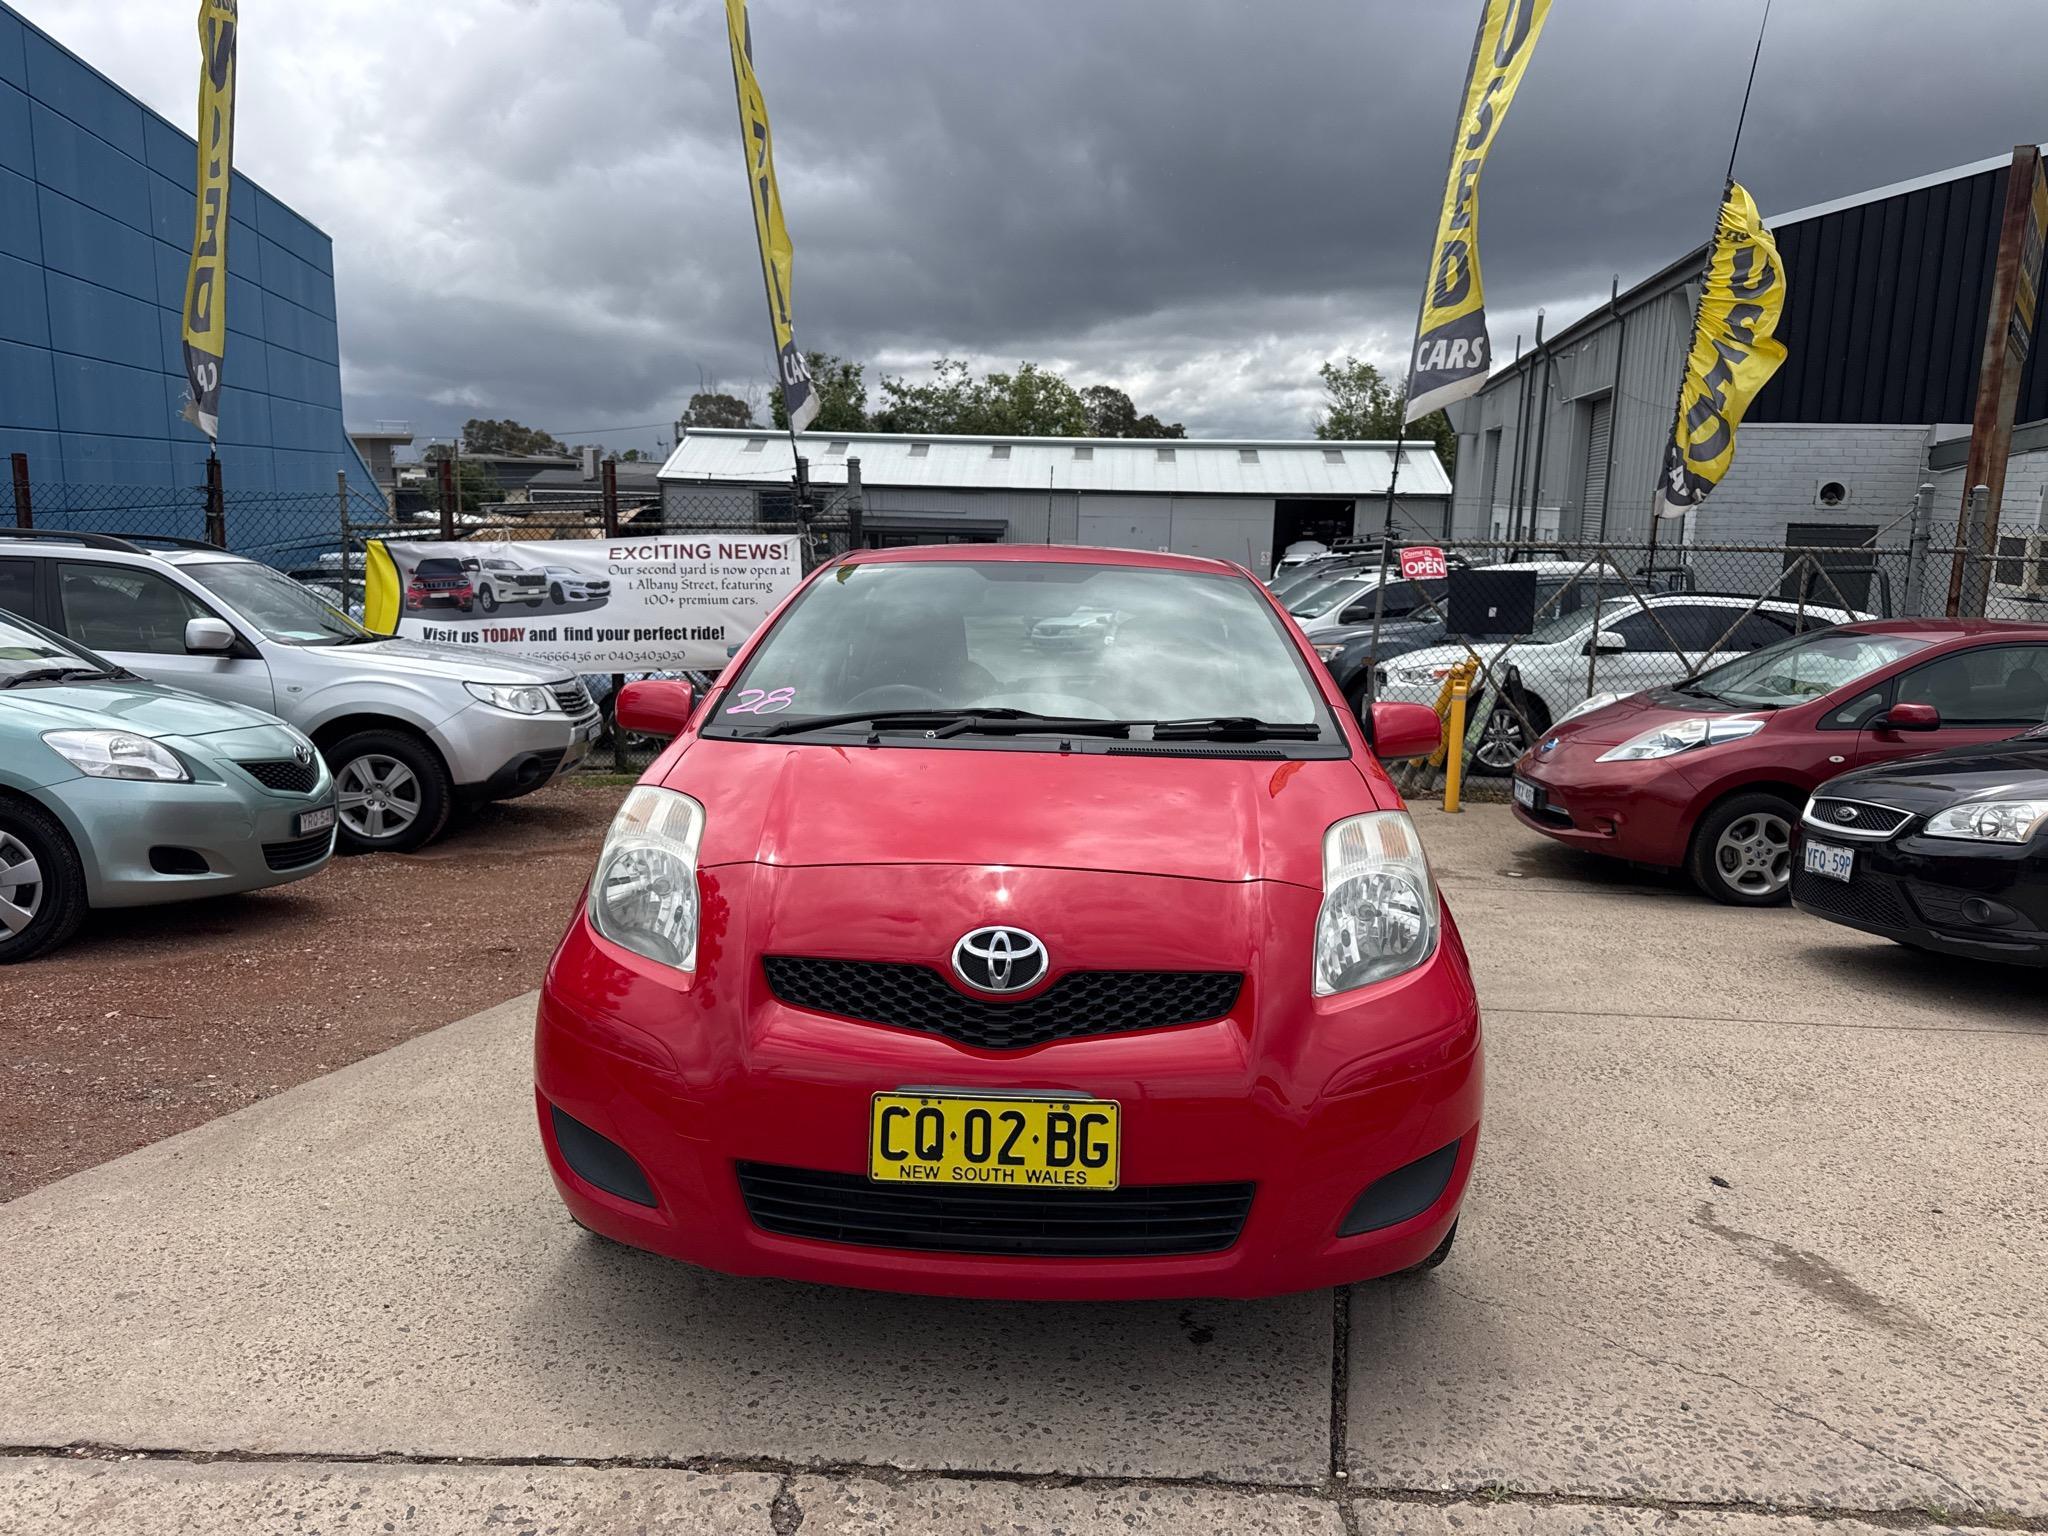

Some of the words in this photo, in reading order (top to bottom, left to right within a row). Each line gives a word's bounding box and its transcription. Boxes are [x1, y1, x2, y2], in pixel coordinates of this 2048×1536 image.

[1416, 337, 1485, 372] CARS
[609, 544, 711, 560] EXCITING
[719, 544, 788, 560] NEWS!
[608, 564, 634, 575] Our
[636, 562, 677, 575] second
[680, 562, 706, 579] yard
[711, 563, 719, 575] is
[723, 565, 747, 575] now
[750, 565, 778, 579] open
[780, 564, 790, 575] at
[1405, 561, 1445, 575] OPEN
[636, 578, 678, 592] Albany
[681, 579, 718, 590] Street,
[721, 578, 773, 593] featuring
[645, 594, 675, 605] 100+
[679, 593, 730, 608] premium
[732, 596, 758, 605] cars.
[423, 627, 458, 642] Visit
[461, 630, 479, 643] us
[482, 627, 525, 643] TODAY
[529, 627, 557, 641] and
[564, 627, 593, 641] find
[596, 628, 630, 642] your
[634, 626, 688, 642] perfect
[691, 626, 725, 640] ride!
[594, 653, 606, 661] or
[609, 650, 686, 663] 0403403030
[726, 687, 796, 715] 28
[900, 1165, 940, 1179] NEW
[952, 1167, 1014, 1182] SOUTH
[1026, 1169, 1087, 1185] WALES
